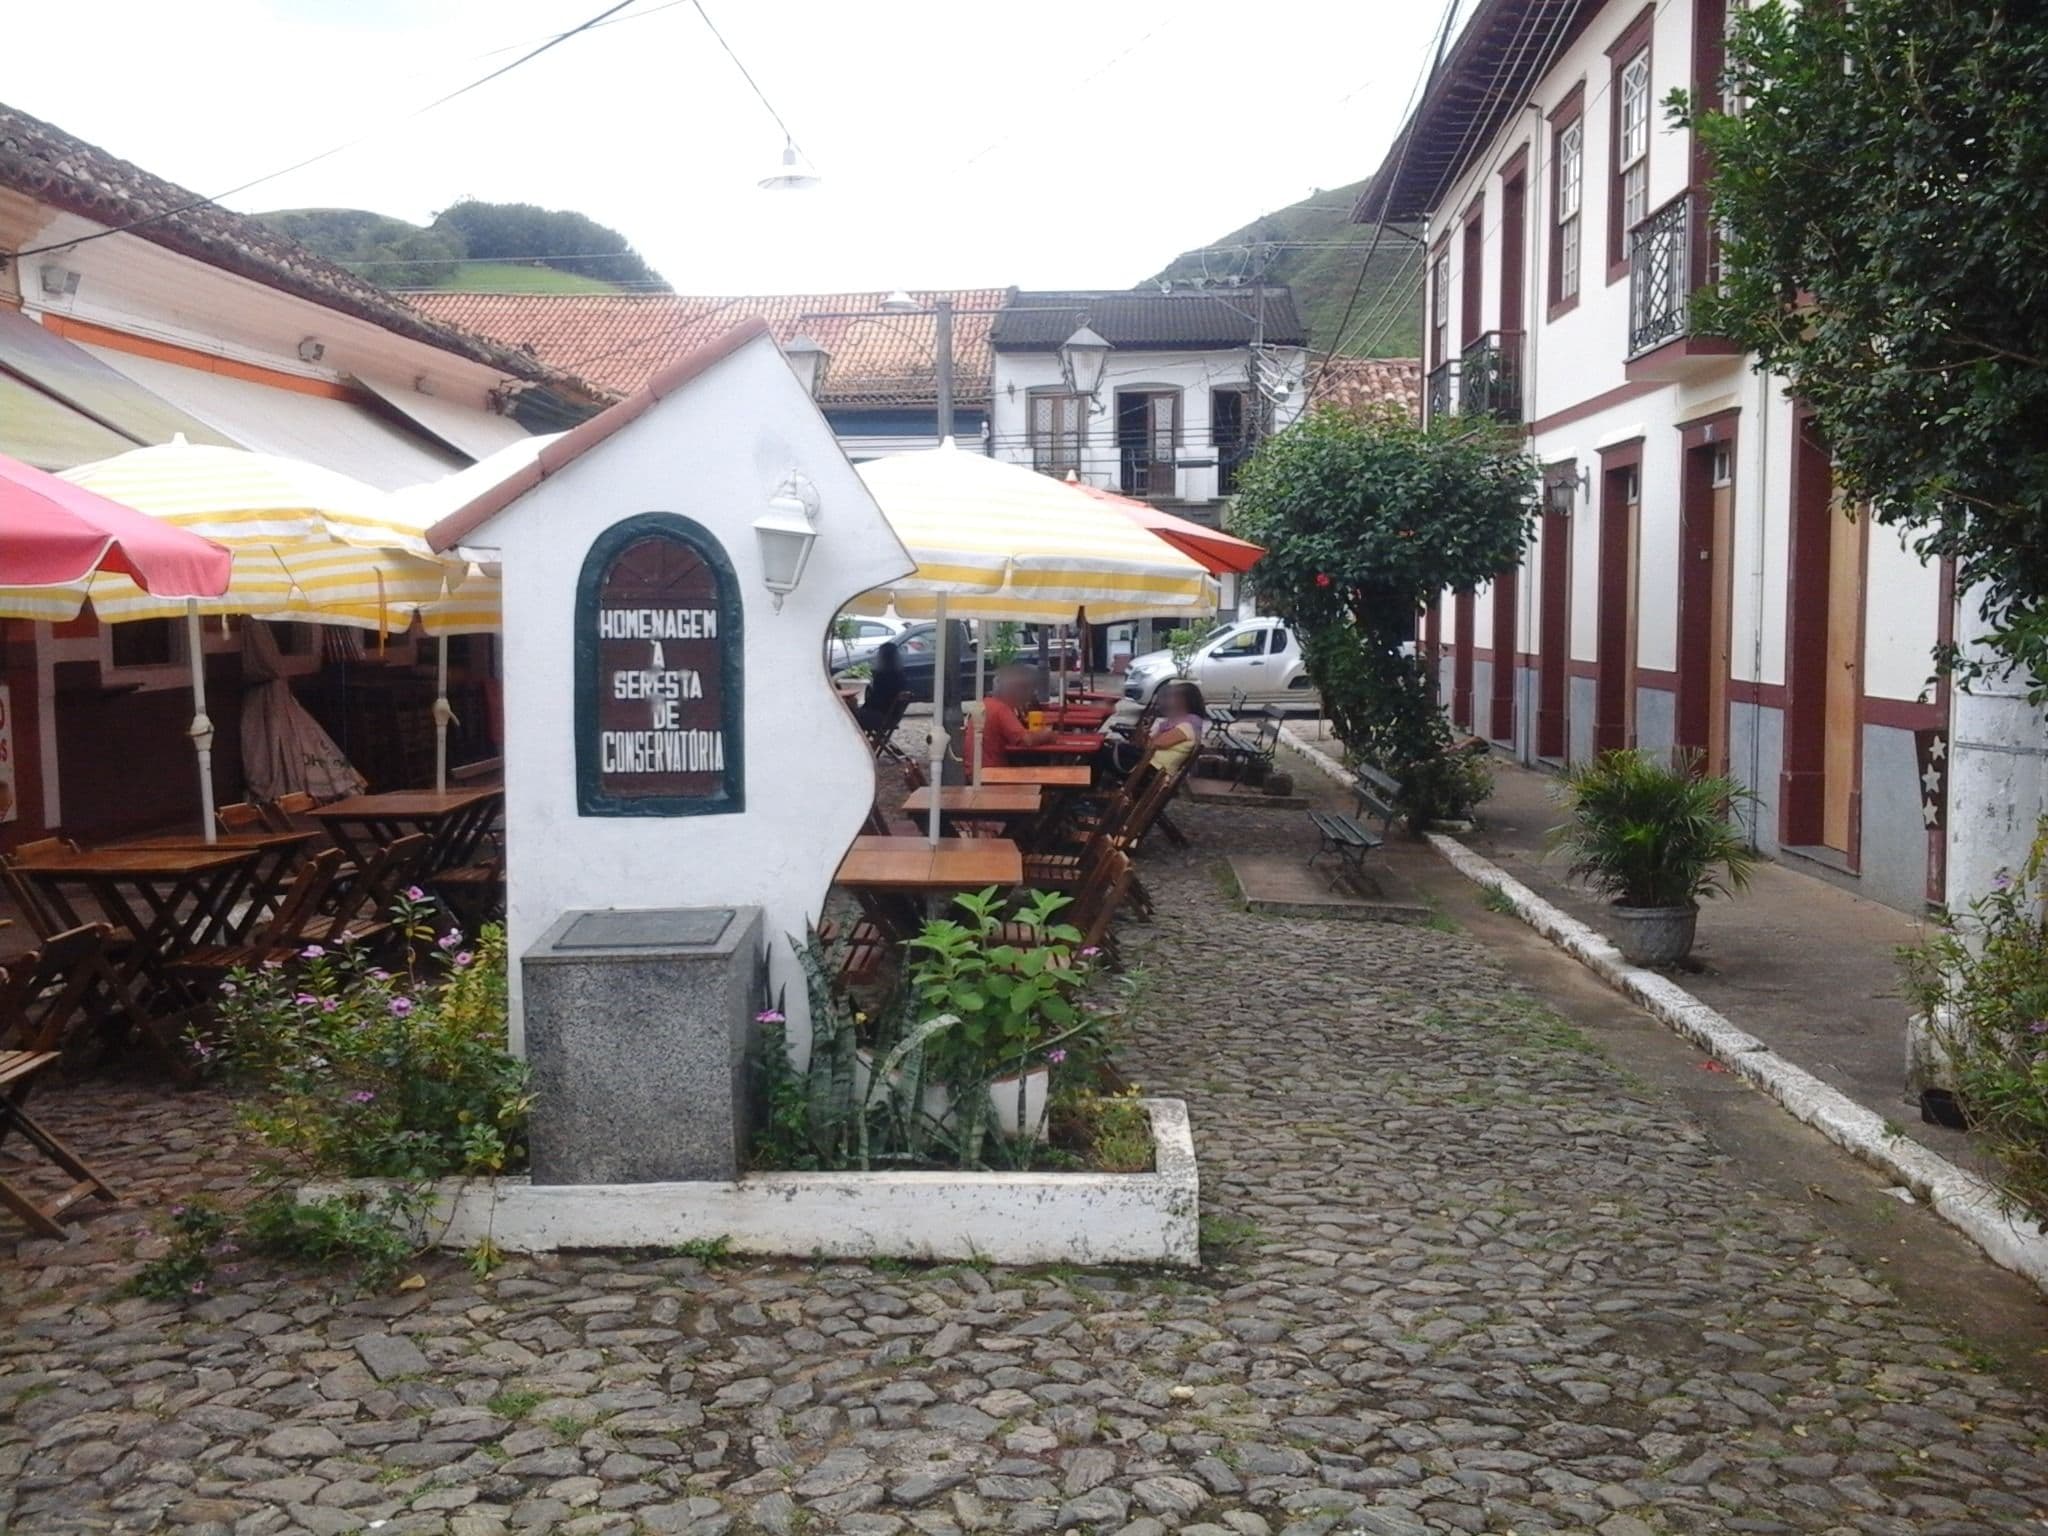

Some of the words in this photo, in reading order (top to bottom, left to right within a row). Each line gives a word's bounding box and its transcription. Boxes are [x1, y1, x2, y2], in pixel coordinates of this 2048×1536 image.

[600, 609, 717, 639] HOMENAGEM
[614, 670, 702, 699] SERESTA
[653, 701, 680, 729] DE
[602, 728, 724, 773] CONSERVATÓRIA
